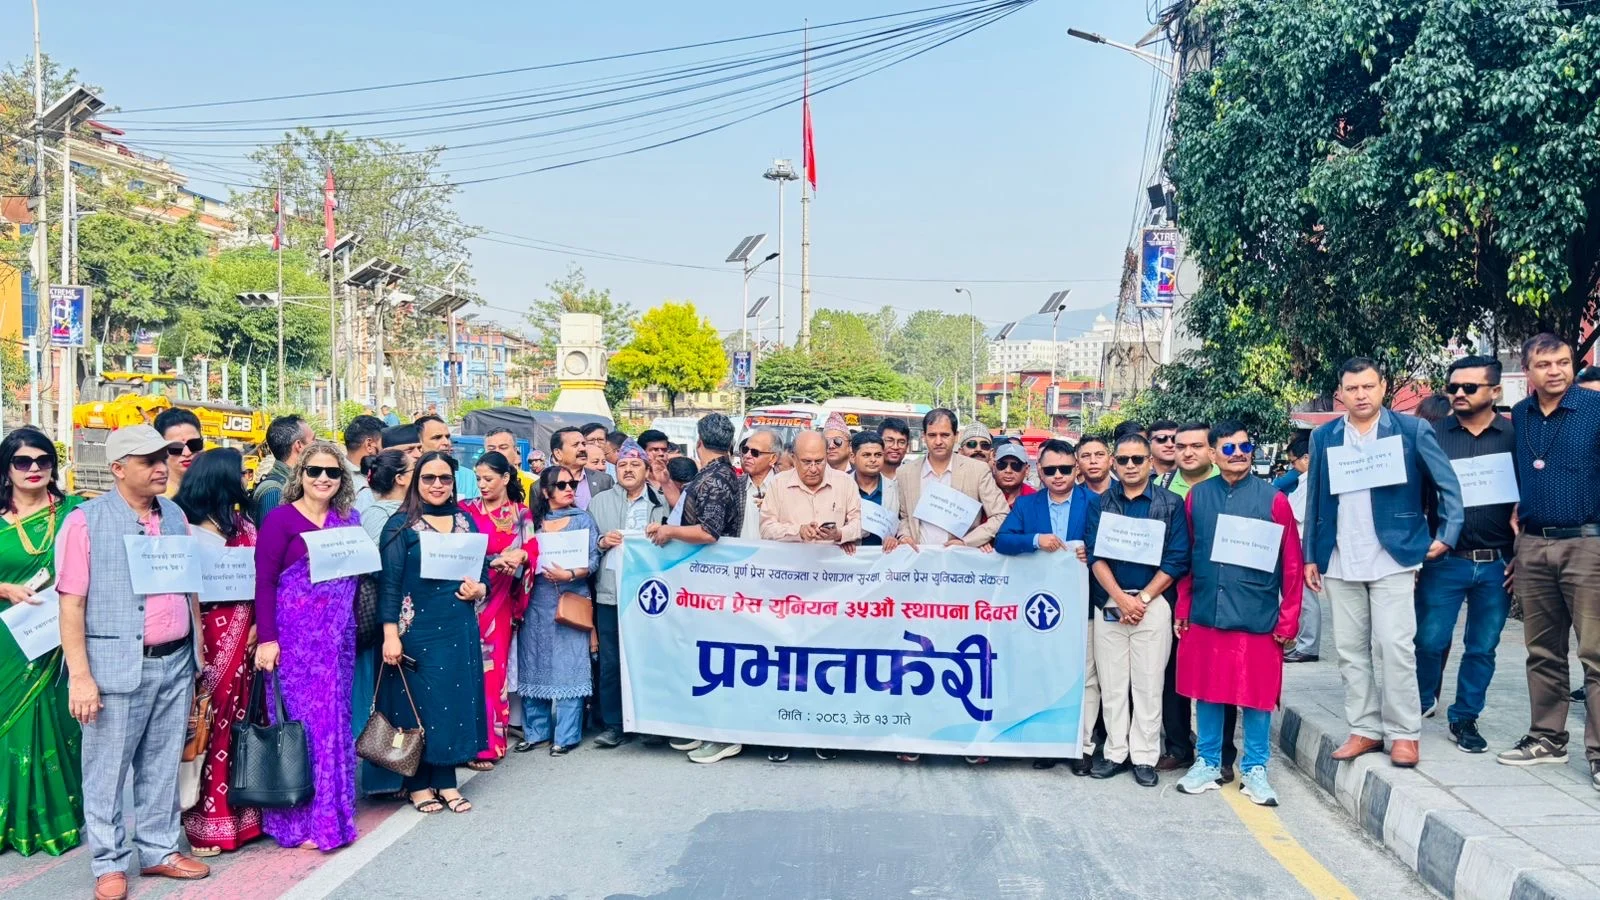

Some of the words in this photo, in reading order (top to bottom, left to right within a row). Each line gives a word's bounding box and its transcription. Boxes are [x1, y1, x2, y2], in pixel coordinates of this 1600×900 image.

[1153, 231, 1176, 241] XTRE
[223, 415, 252, 431] JCB
[689, 560, 730, 576] लोकतन्त्र,
[734, 564, 748, 579] पूर्ण
[750, 565, 765, 579] प्रेस
[768, 568, 810, 581] स्वतन्त्रता
[812, 571, 819, 582] र
[822, 569, 854, 583] पेशागत
[856, 572, 881, 586] सुरक्षा,
[885, 568, 911, 582] नेपाल
[913, 568, 929, 584] प्रेस
[931, 570, 976, 586] युनियनको
[978, 572, 1010, 586] संकल्प
[676, 587, 727, 610] नेपाल
[732, 591, 763, 614] प्रेस
[769, 594, 839, 619] युनियन
[901, 601, 969, 620] स्थापना
[975, 600, 1018, 622] दिवस
[692, 630, 997, 722] प्रभातफेरी
[778, 708, 802, 721] मिति
[816, 713, 848, 725] २०८३,
[853, 710, 871, 724] जेठ
[874, 715, 889, 725] १३
[892, 711, 912, 725] गते
